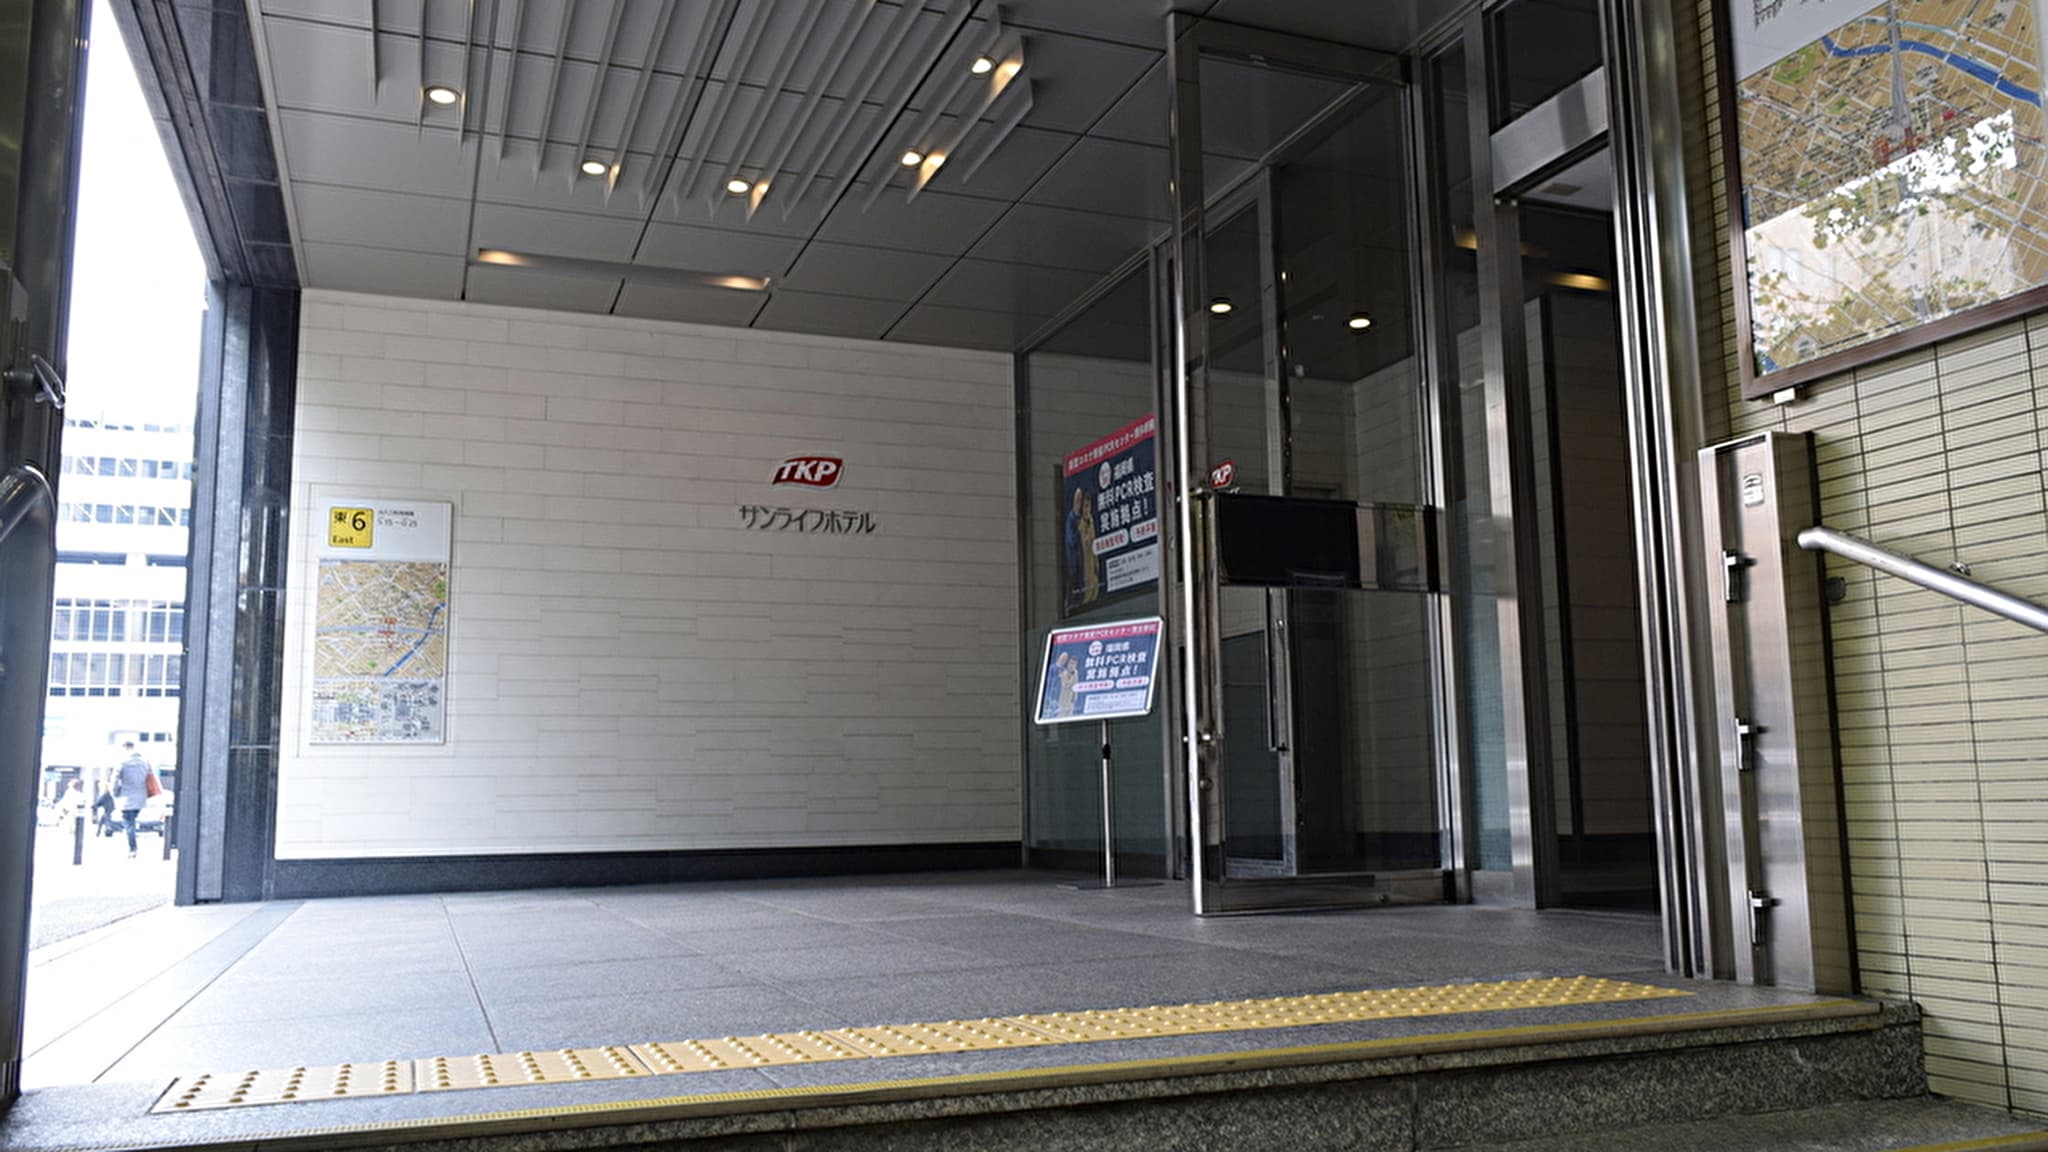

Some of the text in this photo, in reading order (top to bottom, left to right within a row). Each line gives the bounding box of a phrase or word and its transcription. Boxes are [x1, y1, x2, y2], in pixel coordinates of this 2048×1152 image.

[778, 459, 838, 482] TKP
[352, 511, 366, 532] 6
[739, 505, 877, 534] サンライフホテル
